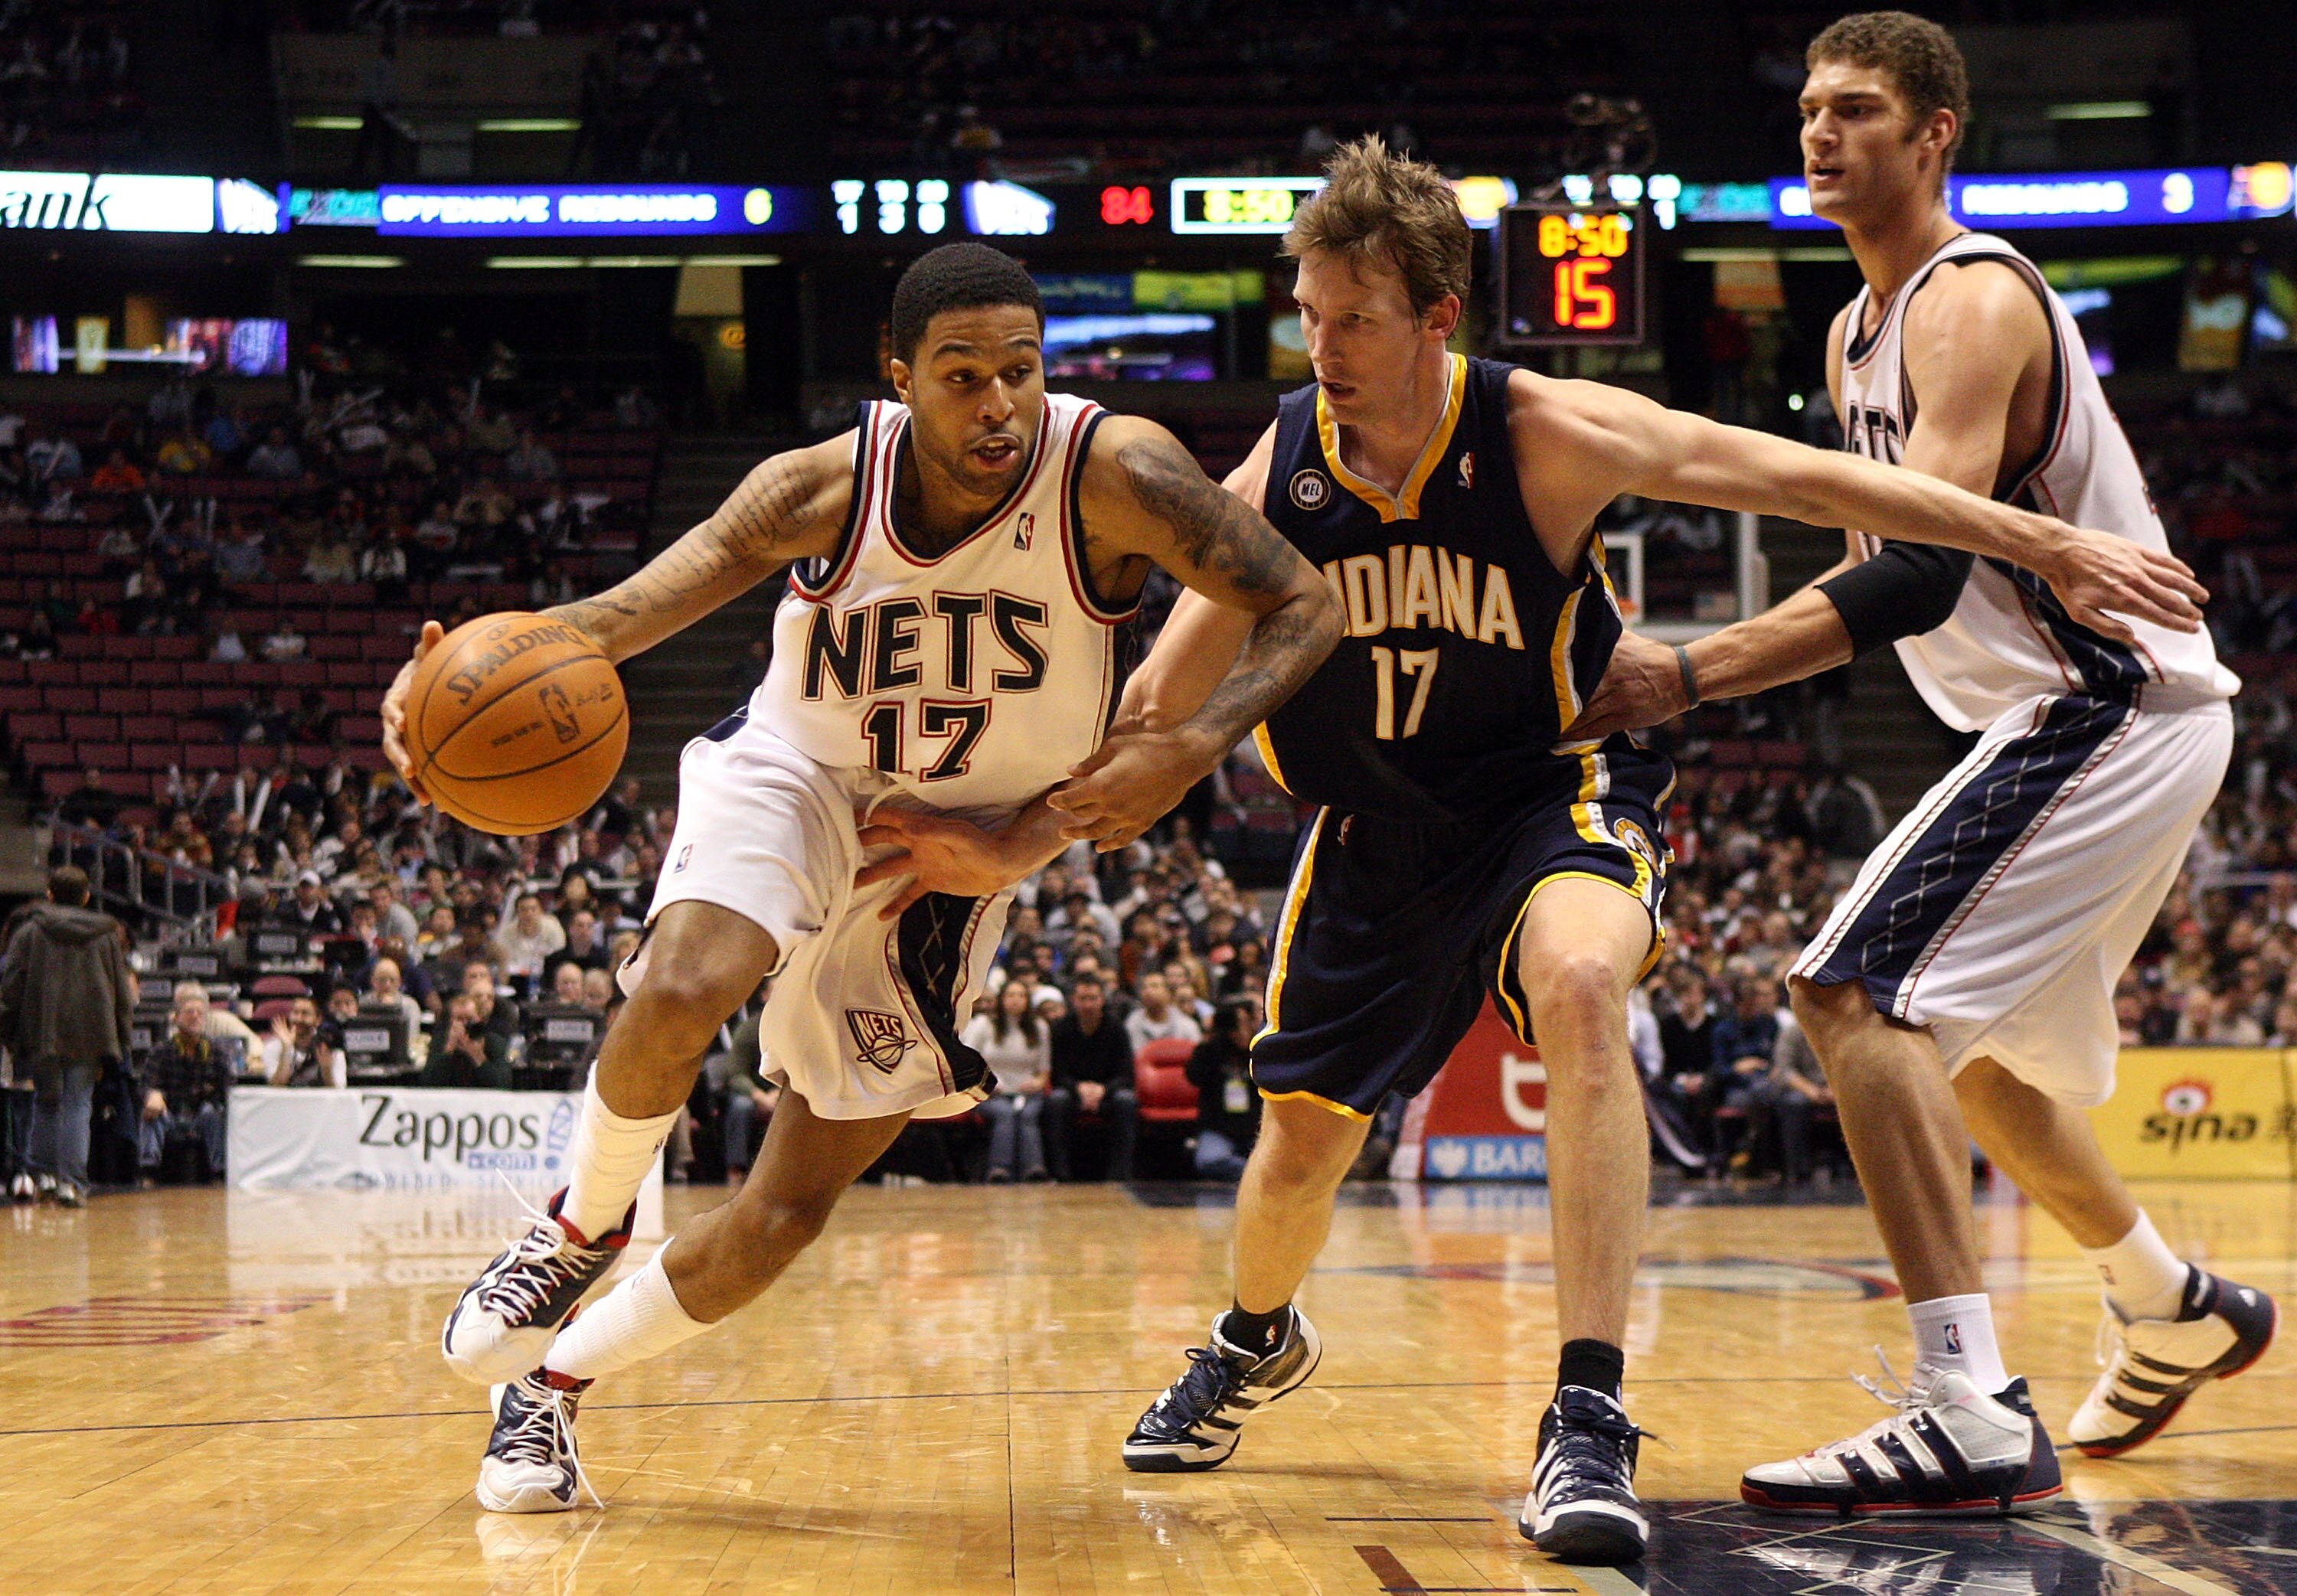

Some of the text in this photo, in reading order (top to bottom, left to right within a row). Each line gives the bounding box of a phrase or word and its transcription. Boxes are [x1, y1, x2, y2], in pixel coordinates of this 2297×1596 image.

[1101, 186, 1152, 224] 84
[1203, 188, 1294, 223] 8:50
[2161, 172, 2194, 214] 3
[1538, 214, 1629, 258] 8:50
[1554, 257, 1616, 330] 15
[1301, 483, 1320, 496] MEL
[446, 623, 590, 706] SPALDING
[801, 589, 1049, 702] NETS
[1371, 645, 1439, 741] 17
[861, 697, 993, 783] 17
[853, 1012, 903, 1047] NETS
[359, 1094, 539, 1162] Zappos
[1473, 1142, 1546, 1173] BAR
